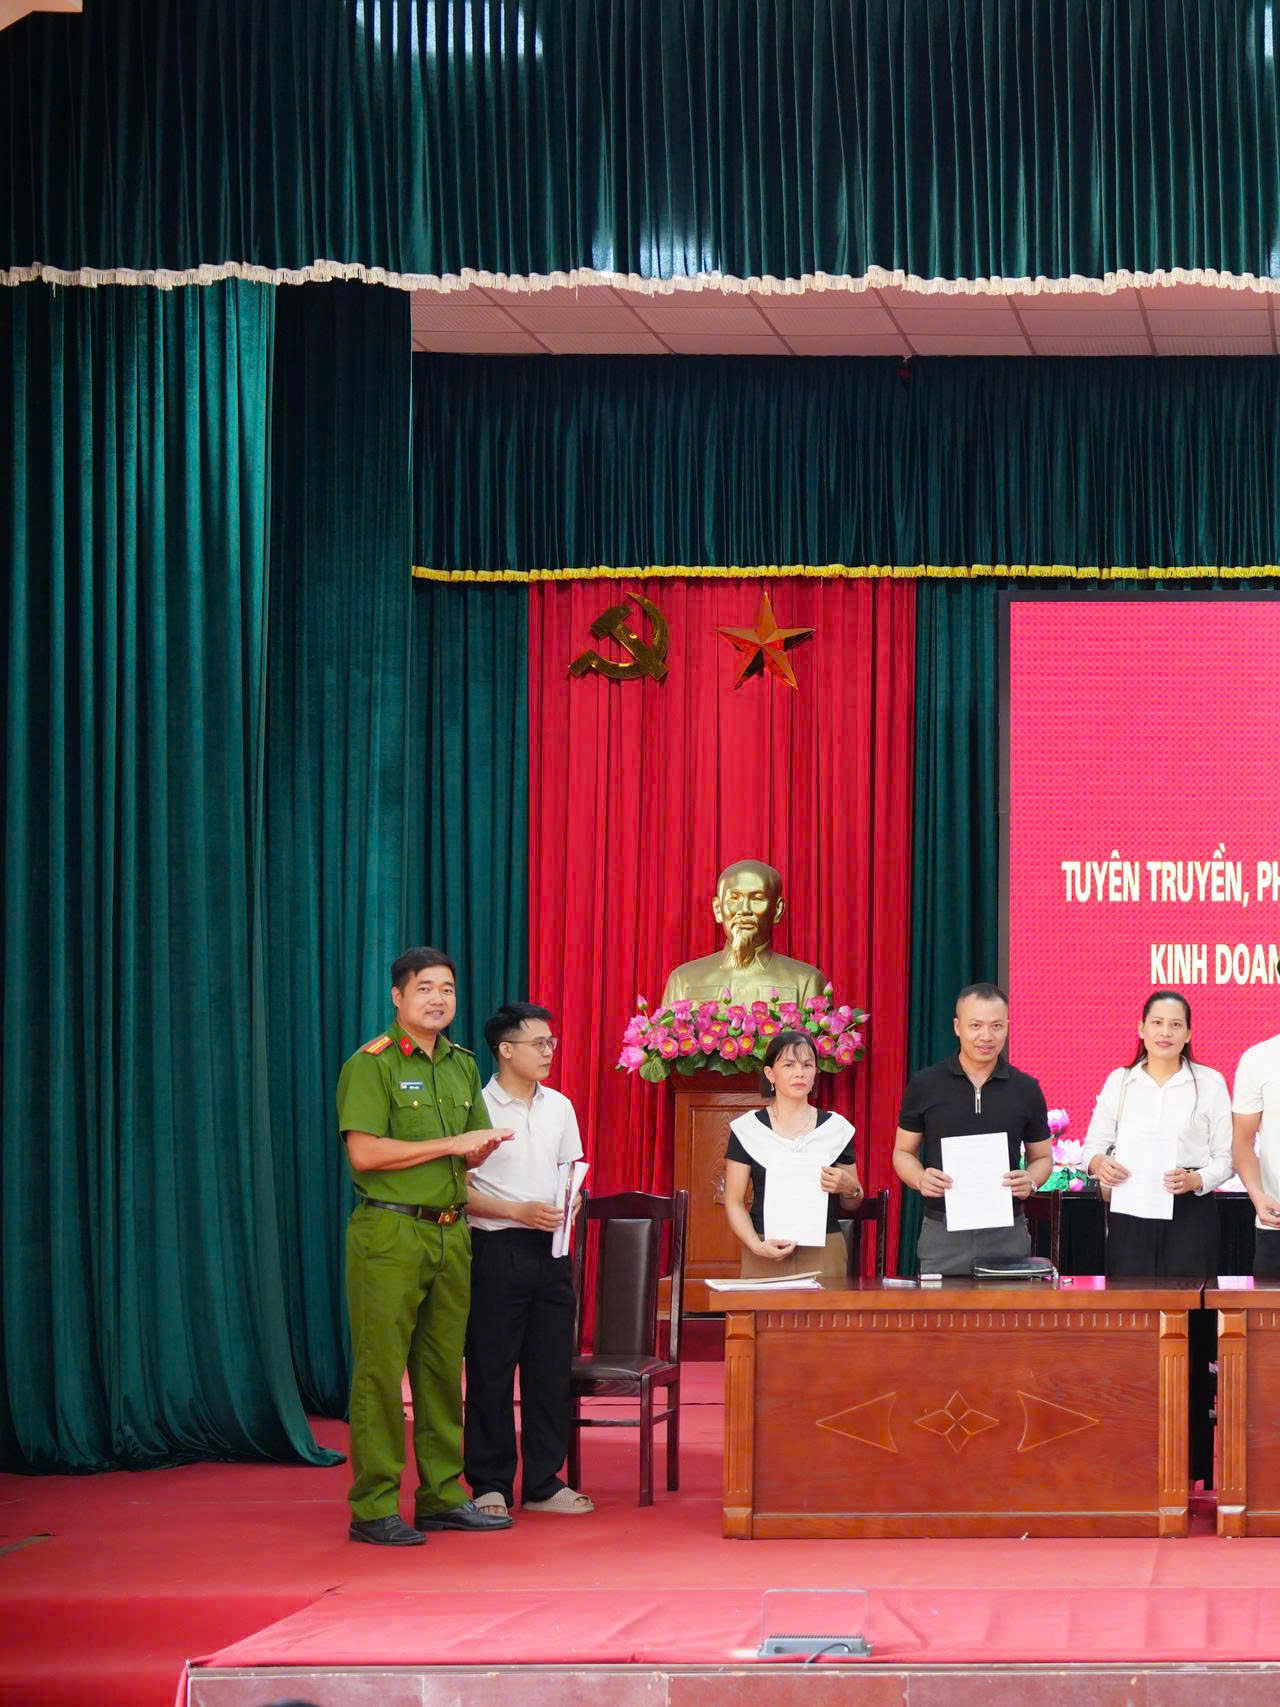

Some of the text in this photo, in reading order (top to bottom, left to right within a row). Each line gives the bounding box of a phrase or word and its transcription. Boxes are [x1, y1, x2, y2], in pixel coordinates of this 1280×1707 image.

[1061, 849, 1141, 903] TUYÊN
[1146, 842, 1250, 908] TRUYỀN,
[1150, 943, 1208, 985] KINH
